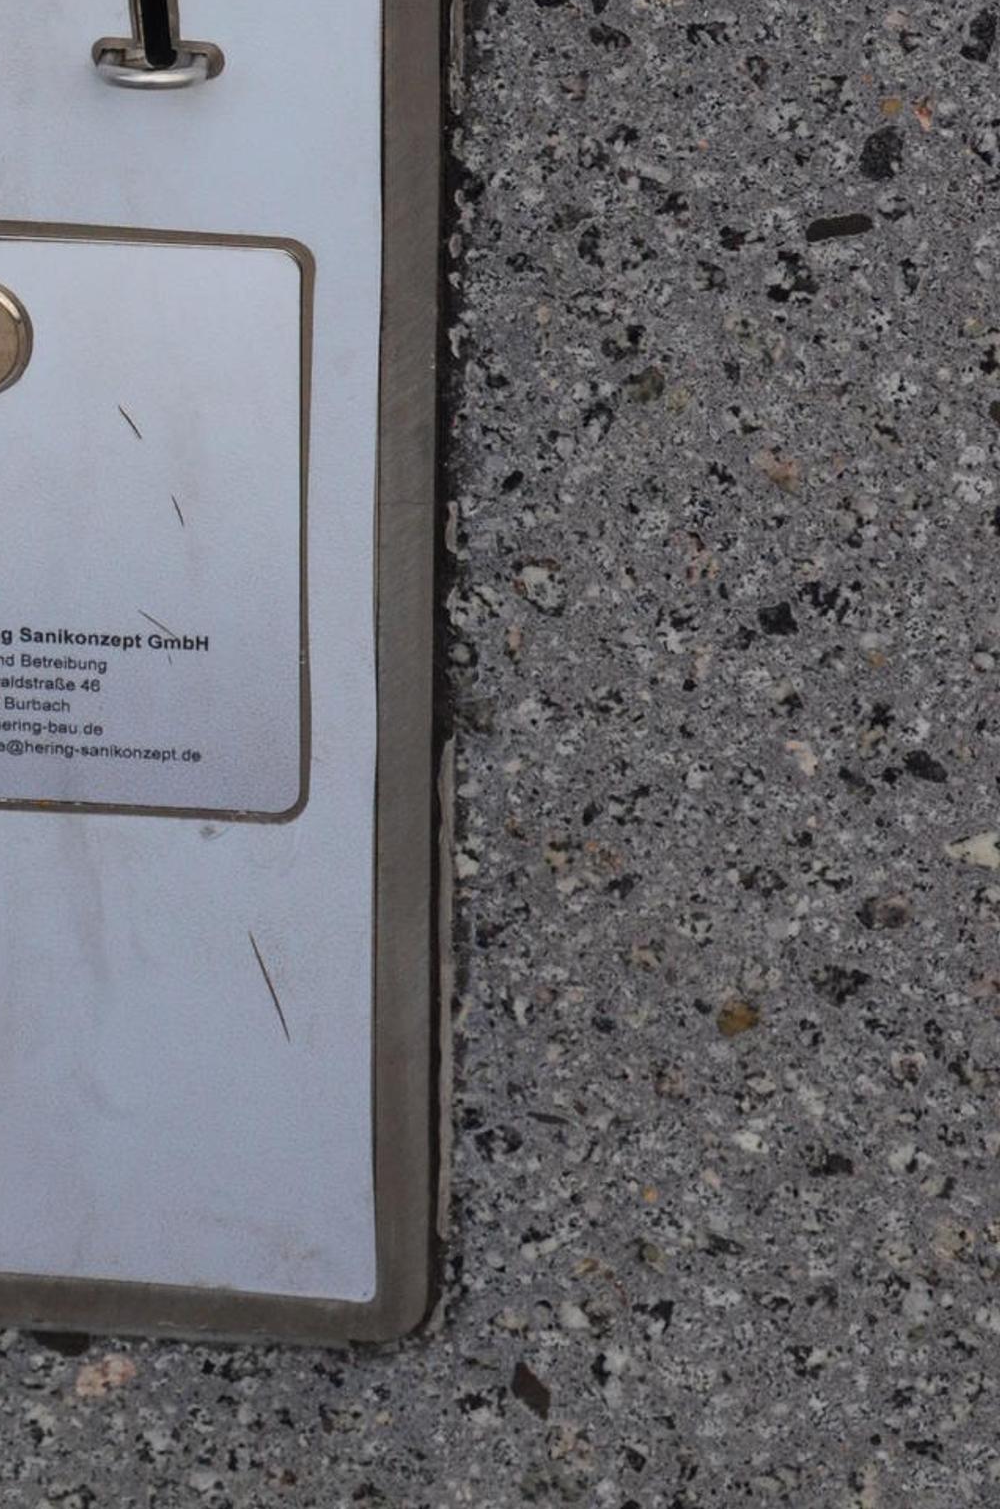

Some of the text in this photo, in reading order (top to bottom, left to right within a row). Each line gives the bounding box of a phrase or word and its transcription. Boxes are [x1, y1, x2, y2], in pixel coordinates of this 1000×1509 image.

[19, 627, 142, 650] Sanikonzept
[148, 634, 209, 652] GmbH
[20, 653, 107, 674] Betreibung
[4, 695, 71, 713] Burbach
